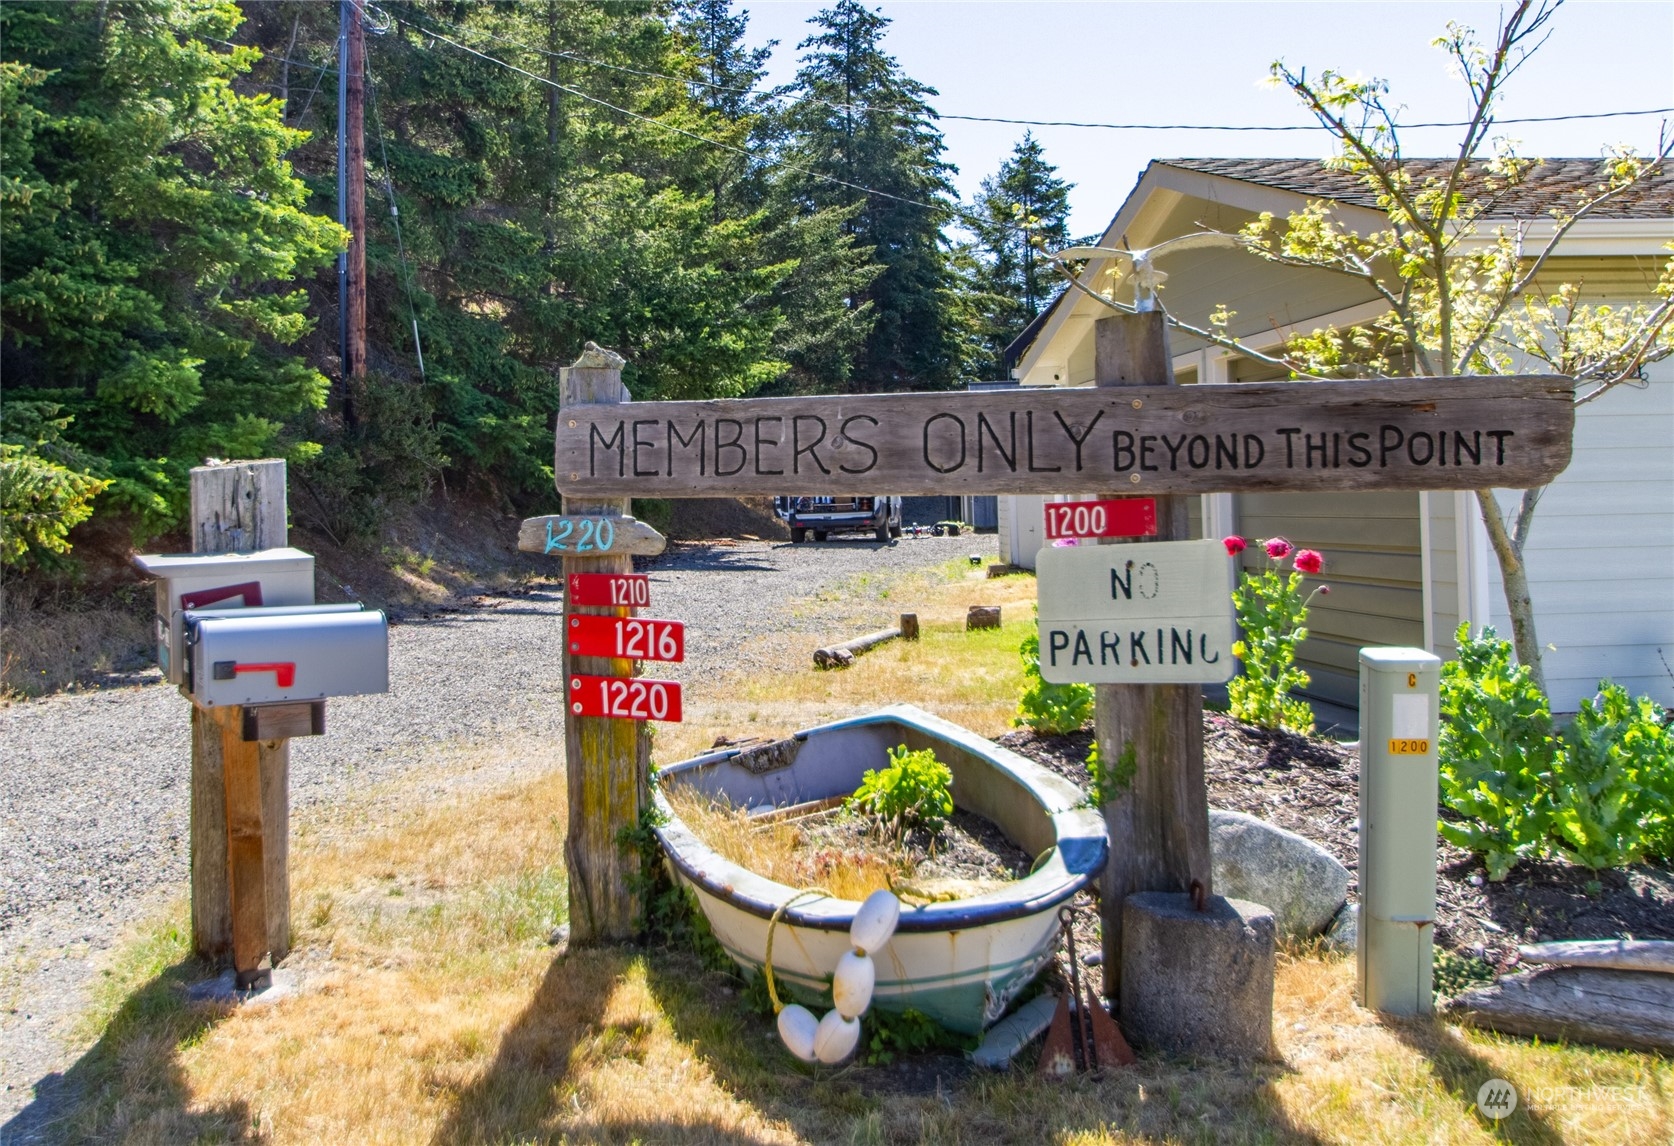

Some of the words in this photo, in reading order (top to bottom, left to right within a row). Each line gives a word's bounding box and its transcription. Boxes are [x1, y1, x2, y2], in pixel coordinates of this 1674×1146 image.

[589, 414, 880, 478] MEMBERS
[923, 409, 1104, 475] ONLY
[1113, 429, 1265, 472] BEYOND
[544, 517, 614, 554] 1220
[1048, 506, 1107, 536] 1200
[610, 578, 648, 605] 1210
[1110, 561, 1160, 600] NO
[615, 620, 677, 659] 1216
[601, 680, 668, 719] 1220
[1392, 741, 1427, 752] 1200
